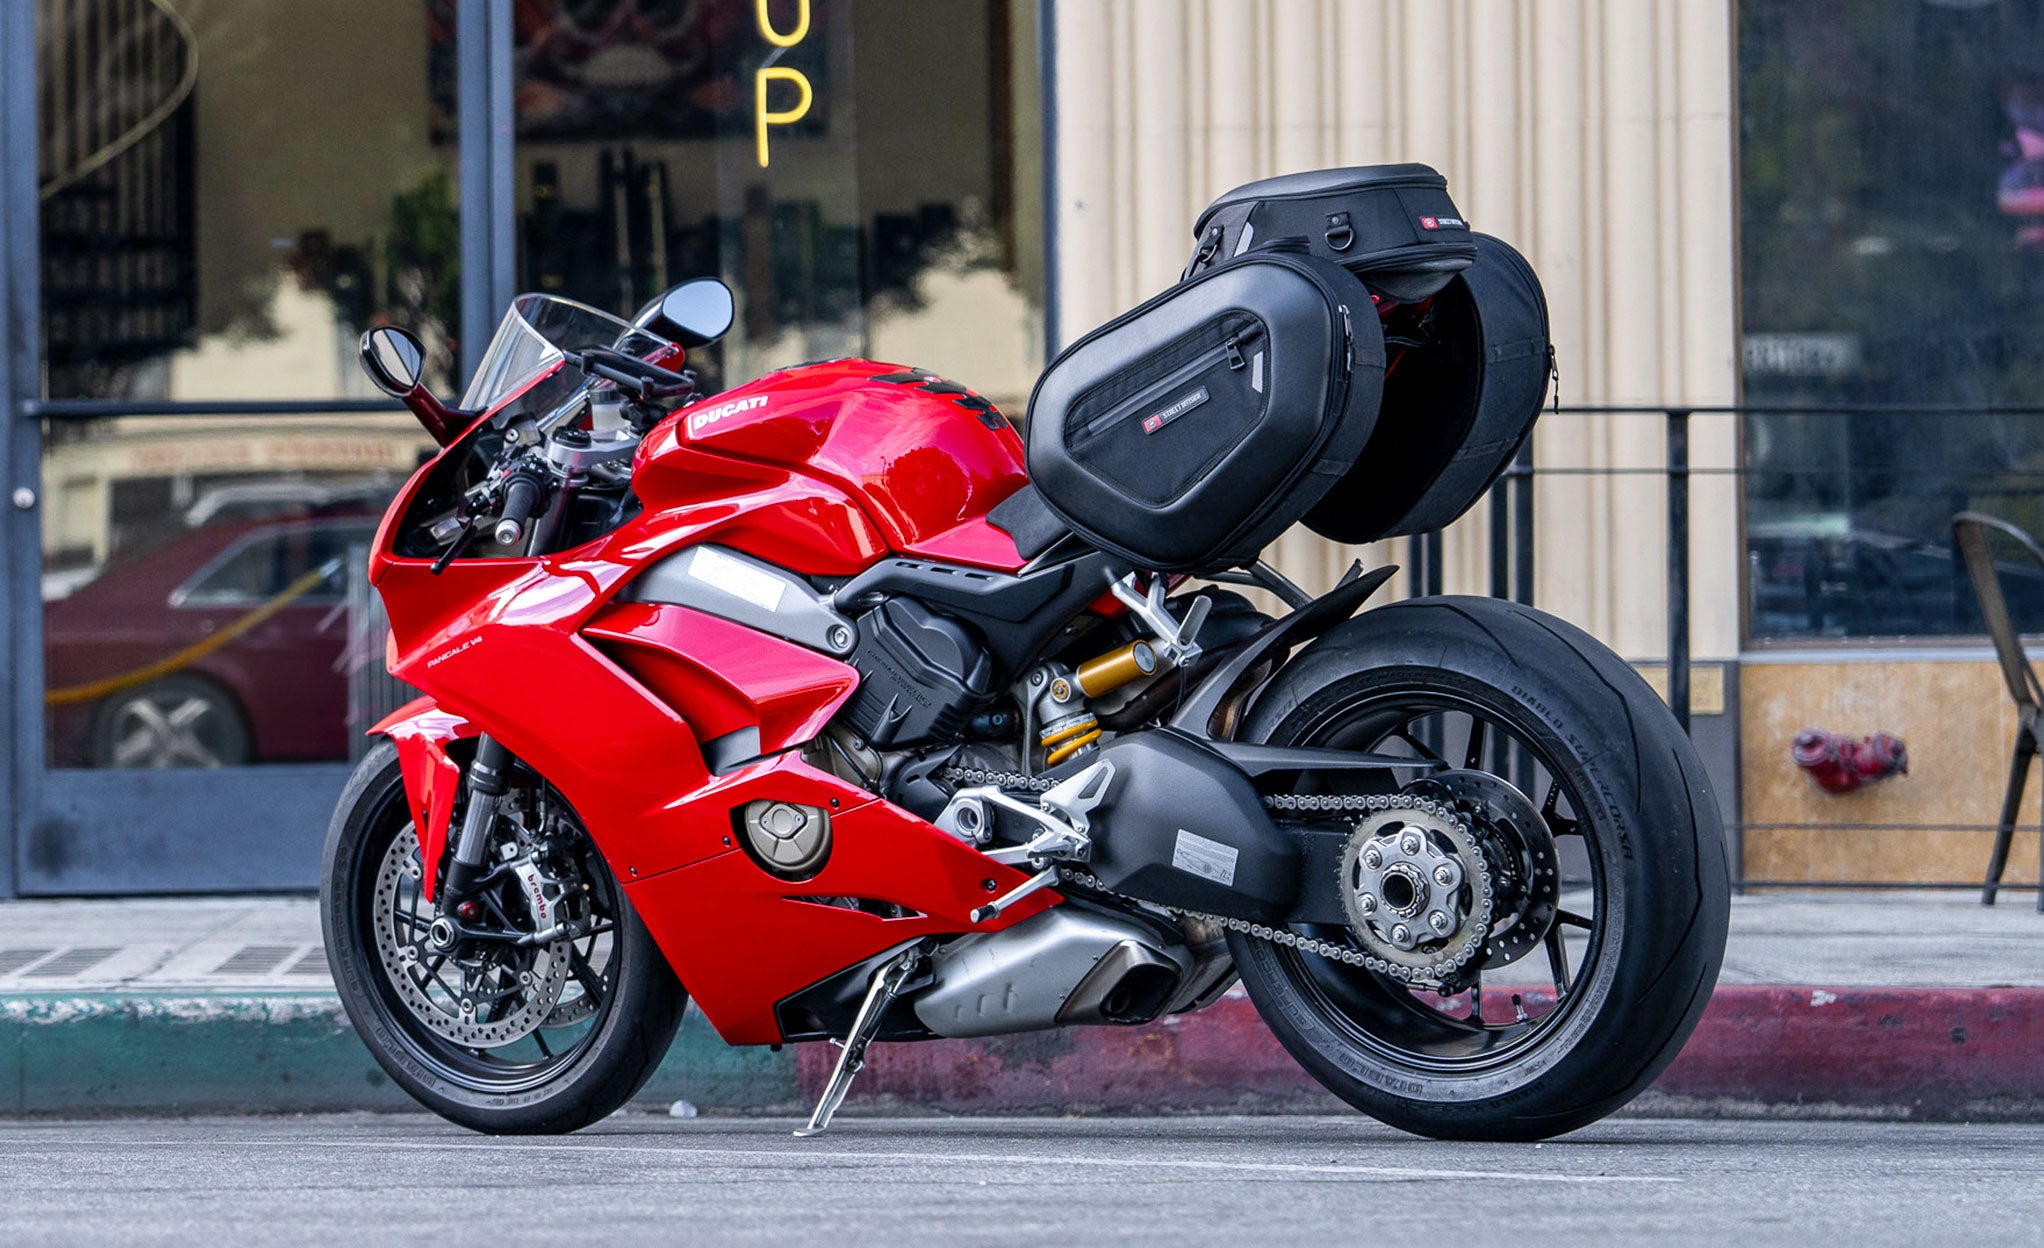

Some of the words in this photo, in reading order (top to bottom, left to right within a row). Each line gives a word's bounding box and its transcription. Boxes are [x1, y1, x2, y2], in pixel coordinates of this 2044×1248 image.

[694, 395, 769, 431] DUCATI
[470, 635, 483, 646] V4
[1511, 685, 1564, 729] DIABLO
[528, 873, 547, 919] brembo
[1252, 938, 1308, 1026] SUPERCO
[1339, 1053, 1424, 1095] DIABLO
